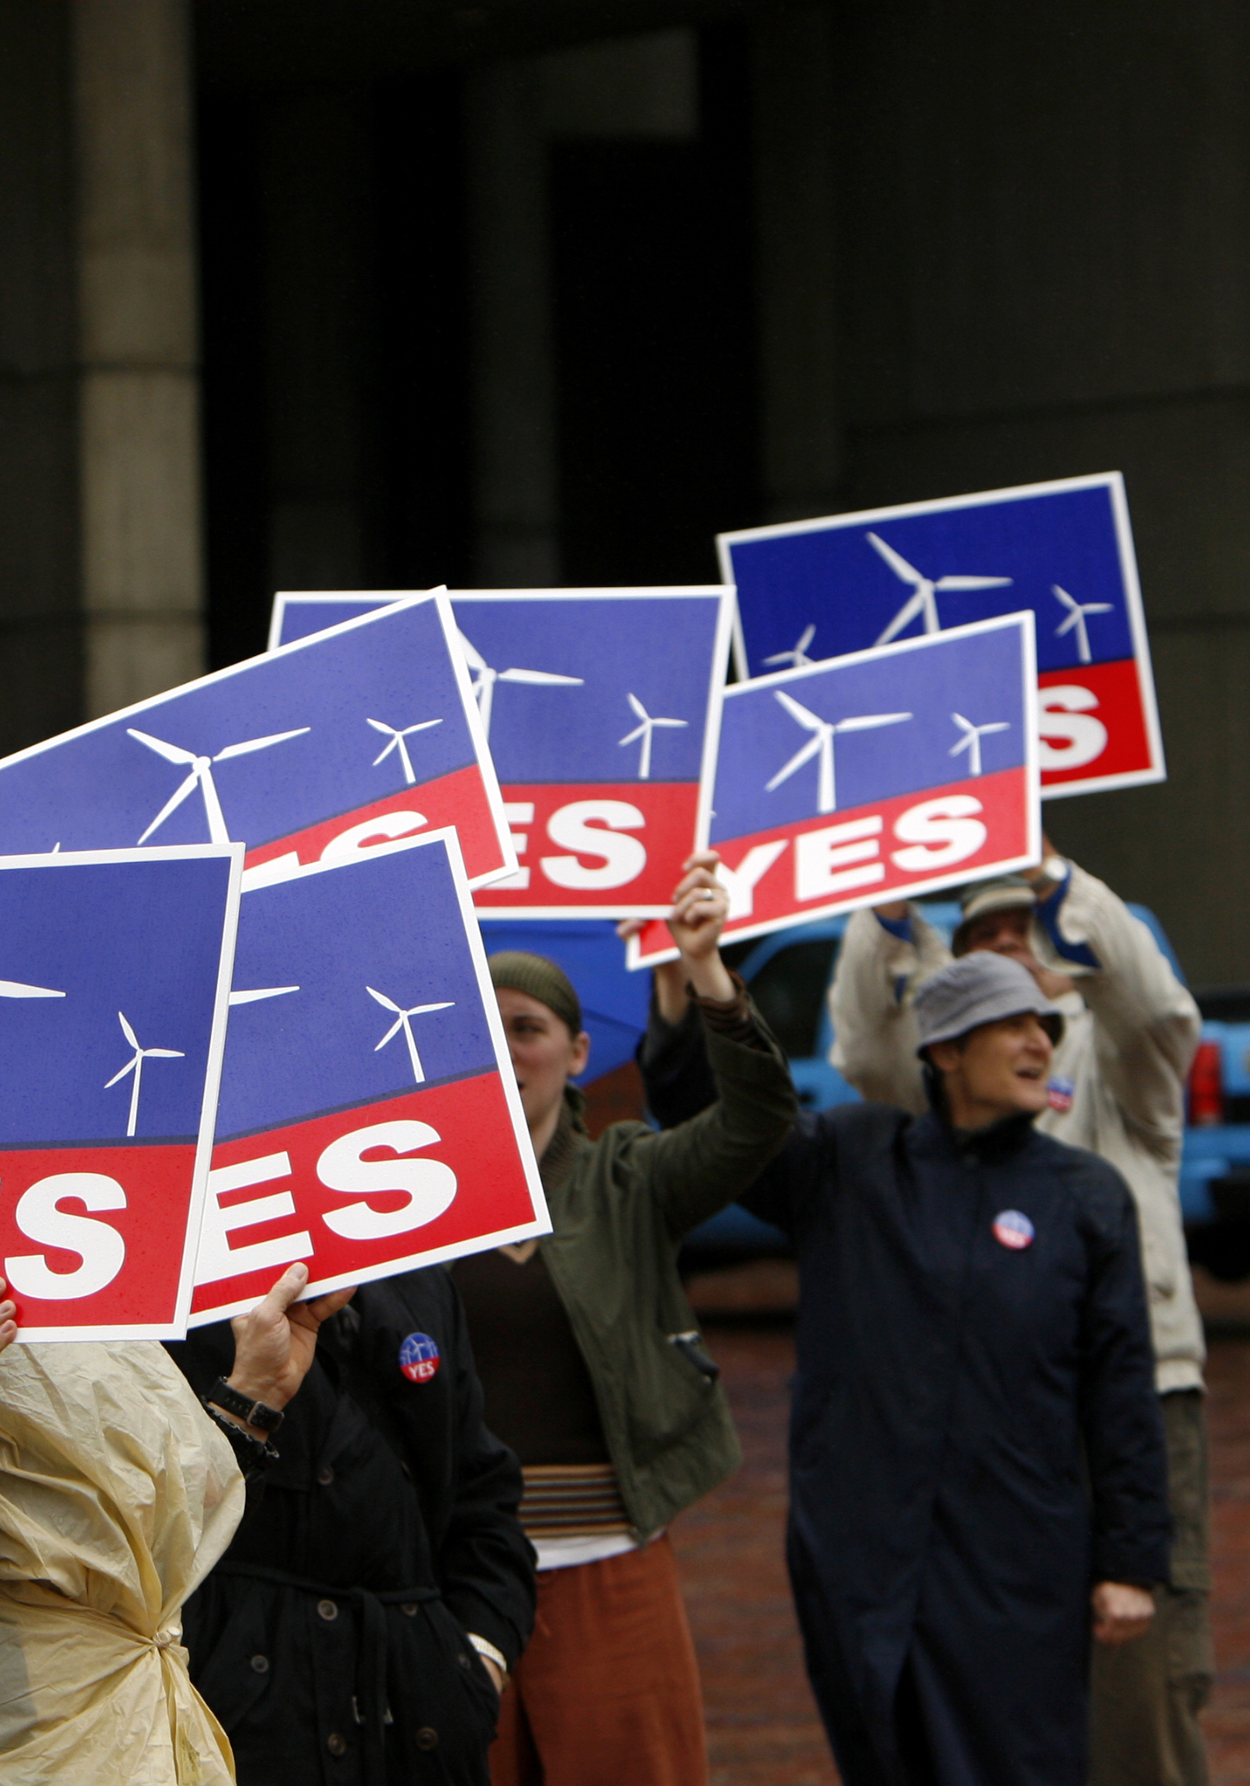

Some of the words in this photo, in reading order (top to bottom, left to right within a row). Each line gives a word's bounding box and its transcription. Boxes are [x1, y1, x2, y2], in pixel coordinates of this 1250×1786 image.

[715, 794, 987, 921] YES
[193, 1120, 458, 1287] ES
[409, 1361, 435, 1379] YES
